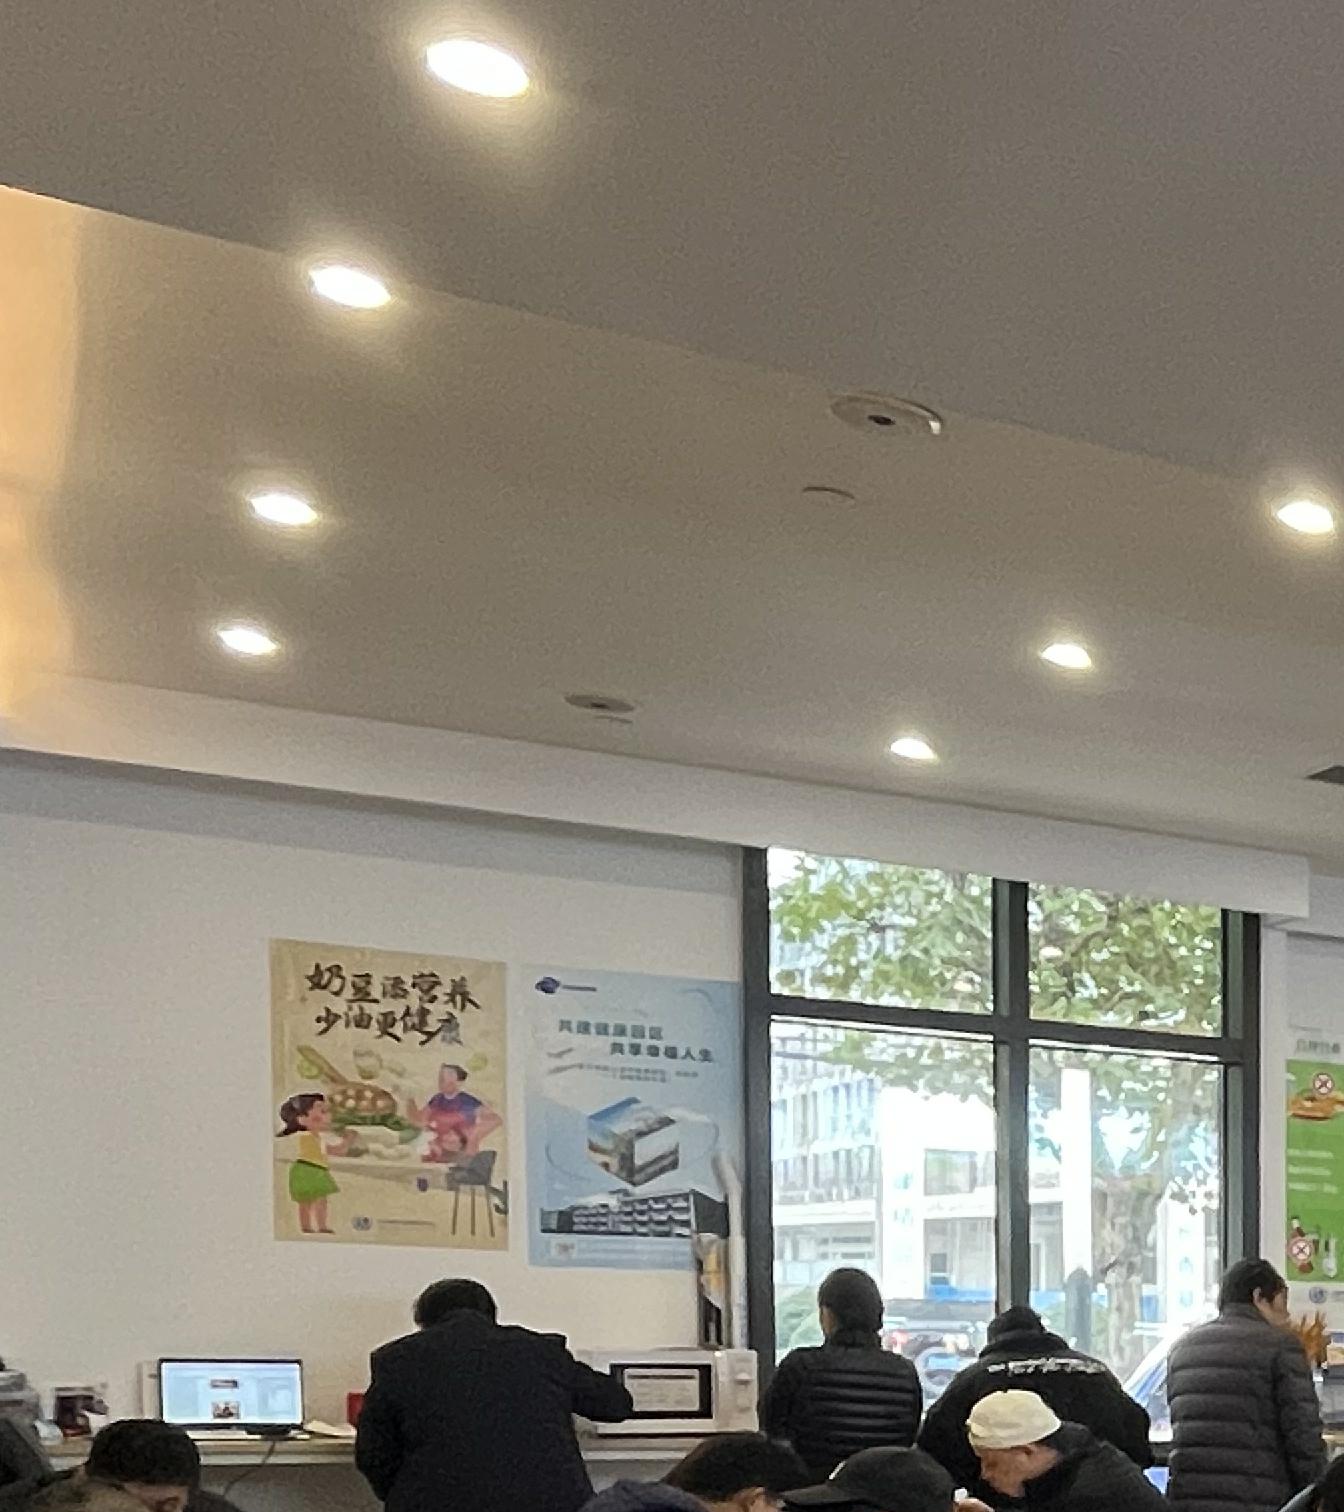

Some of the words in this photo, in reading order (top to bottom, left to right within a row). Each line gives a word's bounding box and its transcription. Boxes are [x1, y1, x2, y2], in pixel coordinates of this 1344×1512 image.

[314, 1004, 464, 1047] 少油更健康
